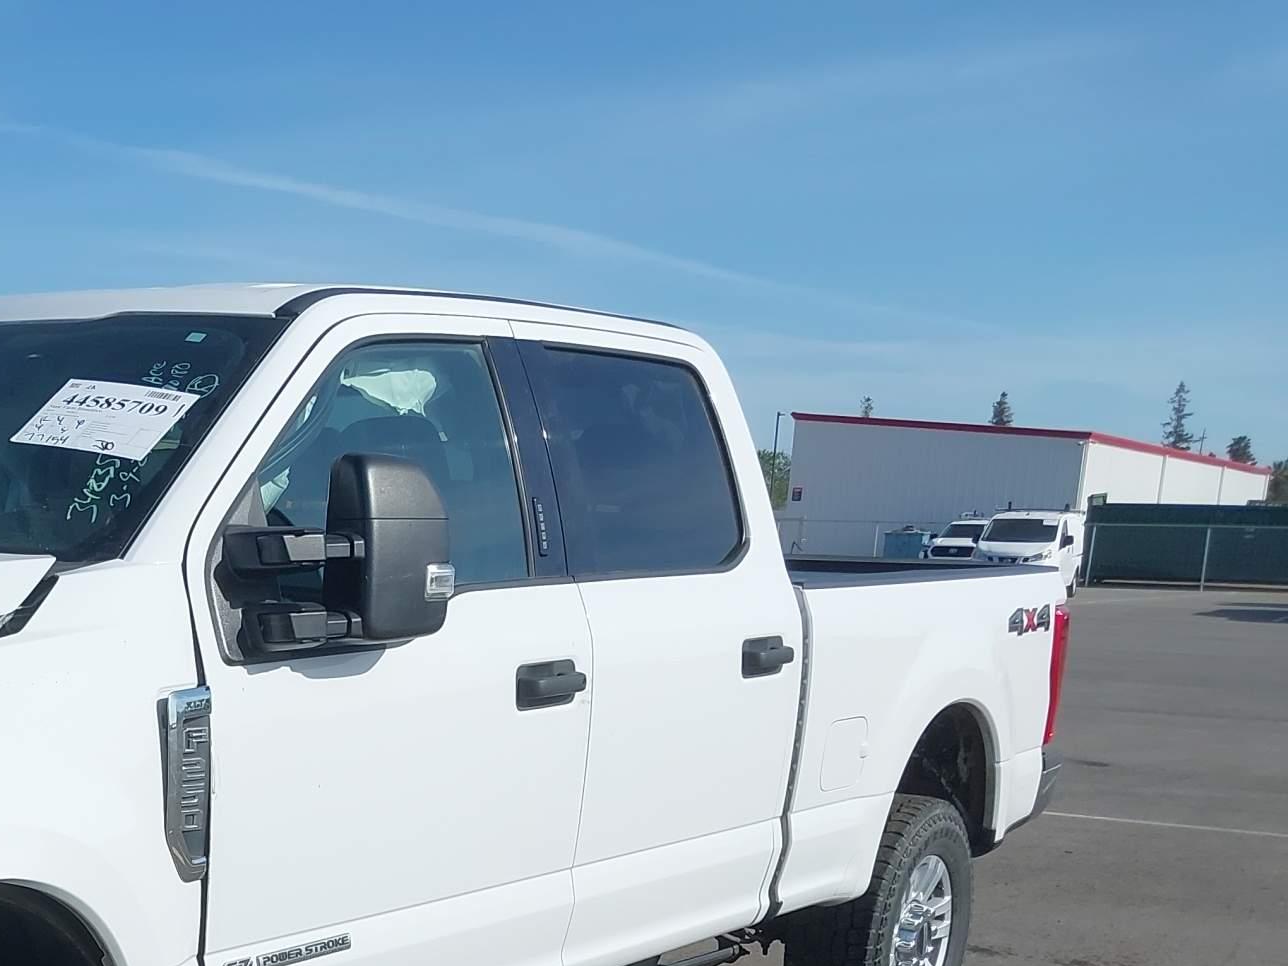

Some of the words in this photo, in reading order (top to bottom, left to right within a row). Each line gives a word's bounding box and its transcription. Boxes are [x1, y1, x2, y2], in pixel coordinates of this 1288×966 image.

[62, 393, 168, 416] 44585709
[262, 947, 303, 966] POWER
[304, 935, 349, 955] STROKE
